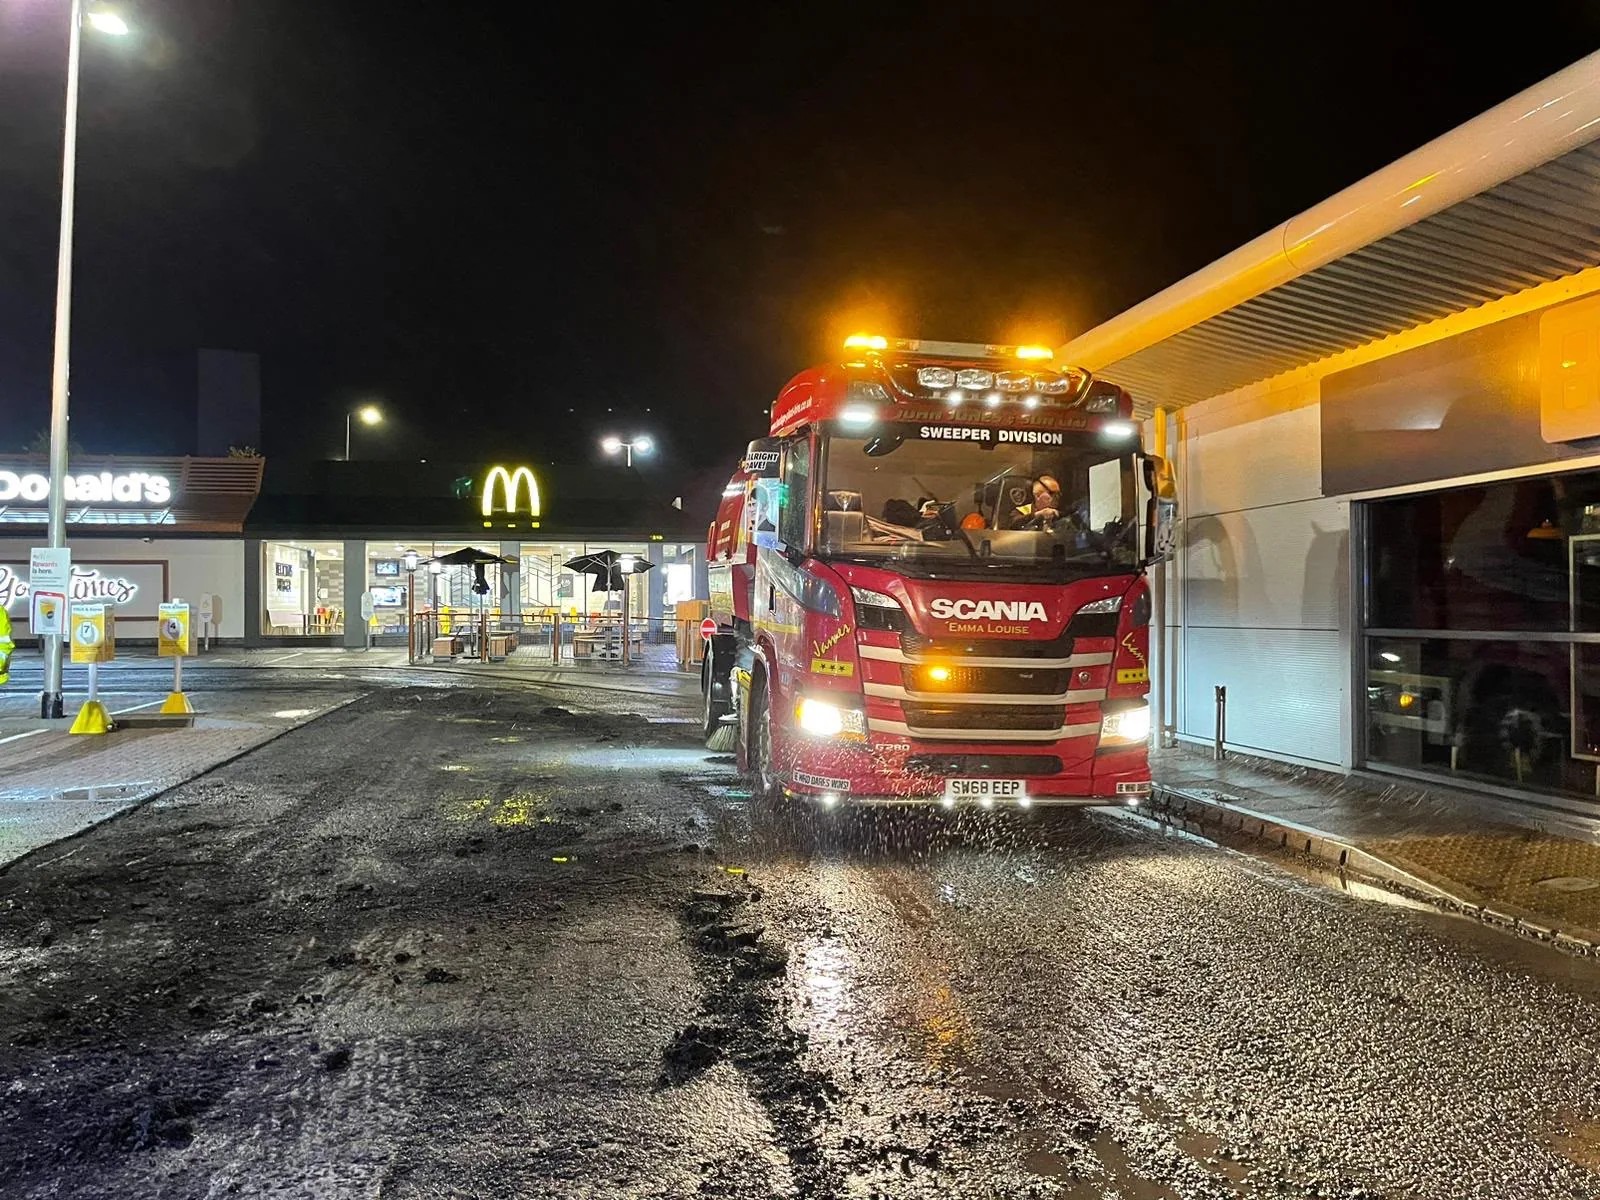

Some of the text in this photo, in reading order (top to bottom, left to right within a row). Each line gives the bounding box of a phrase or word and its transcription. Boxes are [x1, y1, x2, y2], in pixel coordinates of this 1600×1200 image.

[920, 426, 1063, 445] SWEEPER DIVISION
[930, 598, 1049, 622] SCANIA
[83, 625, 90, 634] 7
[170, 622, 176, 630] 4
[948, 622, 1029, 634] EMMA LOUISE
[813, 624, 851, 657] James
[875, 743, 910, 751] G280
[810, 776, 830, 788] DARES
[831, 779, 850, 790] WINS!
[952, 781, 1020, 795] SW68 EEP
